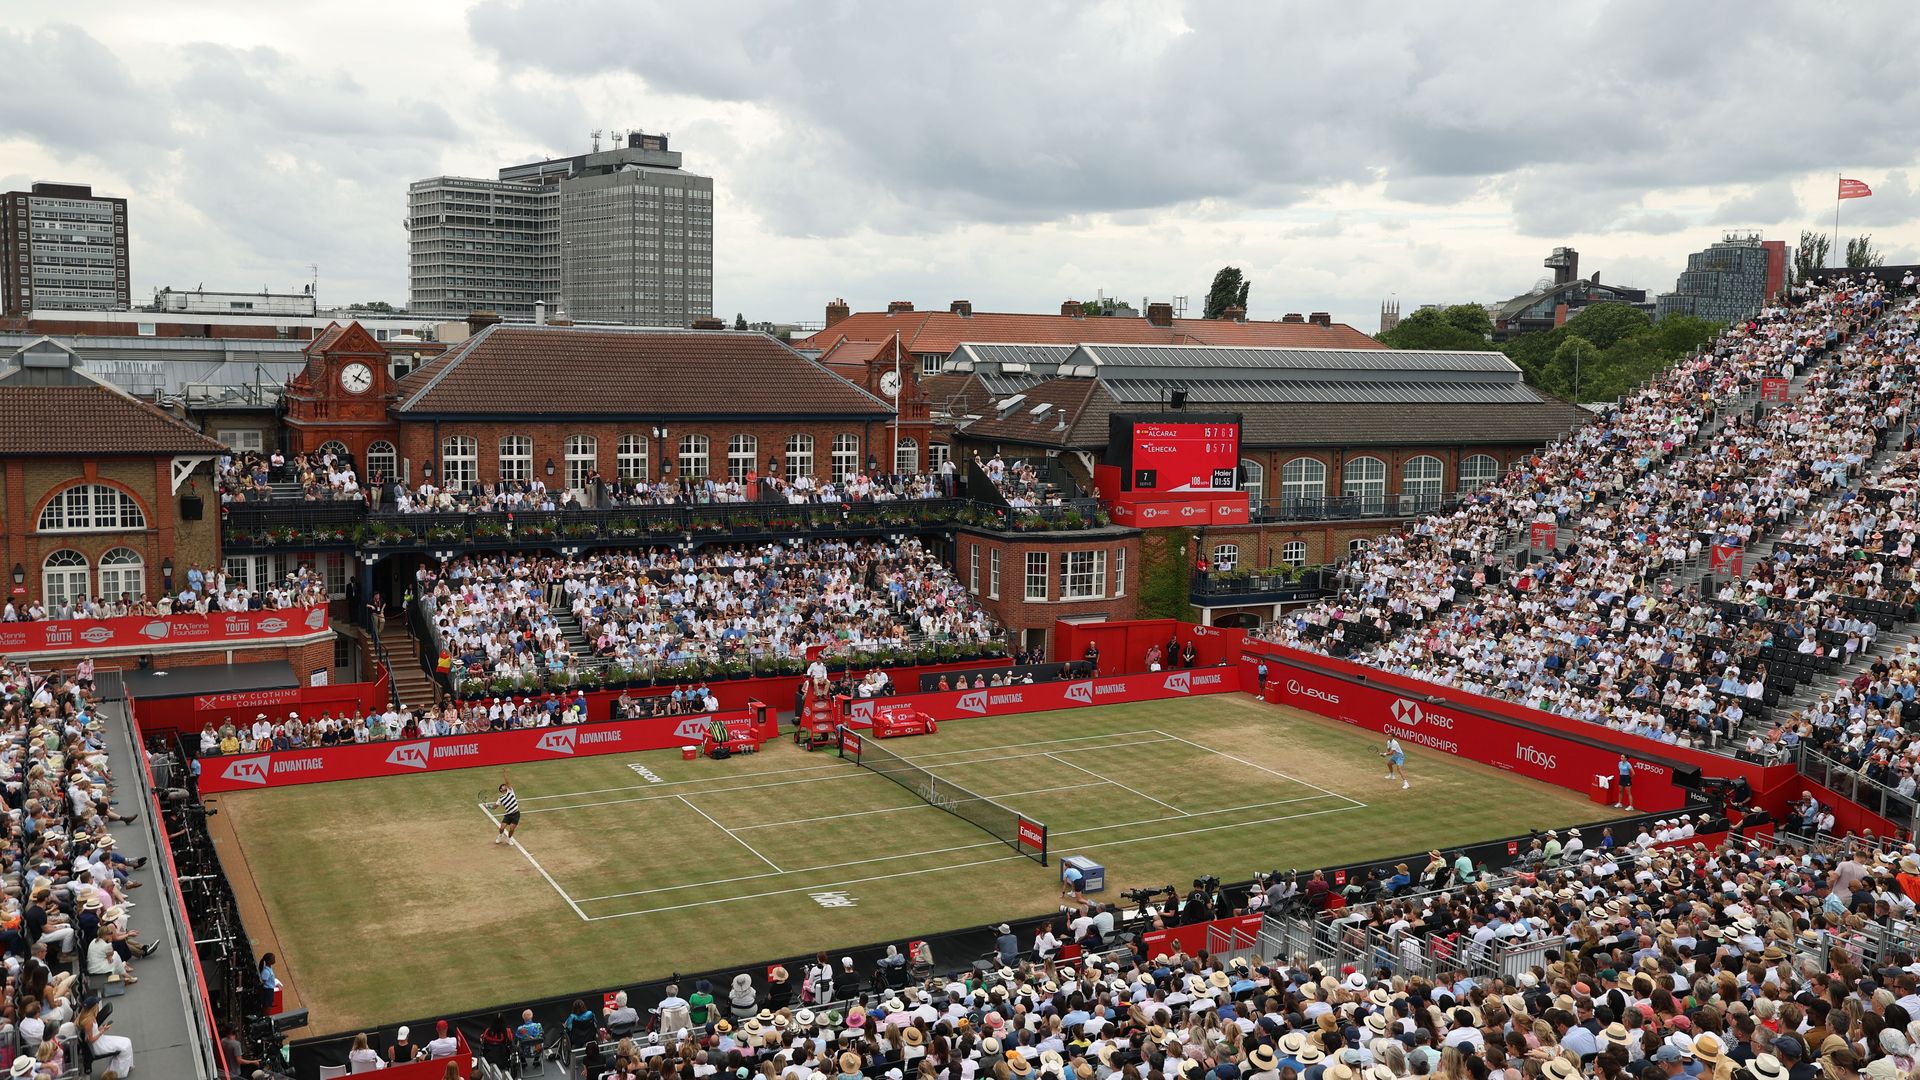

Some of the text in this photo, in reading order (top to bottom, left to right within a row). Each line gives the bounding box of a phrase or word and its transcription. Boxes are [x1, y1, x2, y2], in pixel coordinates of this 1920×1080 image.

[1204, 427, 1211, 438] 15
[1213, 427, 1218, 438] 7
[1221, 427, 1226, 438] 6
[1228, 427, 1233, 438] 3
[1205, 443, 1211, 453] 0
[1213, 443, 1218, 453] 5
[1220, 443, 1225, 453] 7
[1143, 472, 1148, 481] 7
[1214, 477, 1231, 486] 01:55
[188, 622, 209, 630] Tennis
[225, 622, 250, 632] YOUTH
[3, 632, 26, 640] Tennis
[46, 631, 72, 643] YOUTH
[173, 629, 209, 637] Foundation
[1169, 674, 1222, 690] LTA ADVANTAGE
[219, 689, 297, 702] CREW CLOTHING
[1070, 683, 1127, 700] LTA ADVANTAGE
[1300, 686, 1340, 704] LEXUS
[236, 698, 281, 708] COMPANY
[963, 693, 1023, 710] LTA ADVANTAGE
[1425, 712, 1455, 730] HSBC
[682, 723, 709, 735] LTA
[545, 730, 622, 751] LTA ADVANTAGE
[1383, 723, 1458, 754] CHAMPIONSHIPS
[396, 743, 479, 766] LTA ADVANTAGE
[1516, 742, 1557, 770] Infosys
[233, 757, 324, 780] LTA ADVANTAGE
[627, 763, 664, 783] LONDON
[1690, 792, 1709, 803] Haier
[1020, 826, 1043, 844] Emirates
